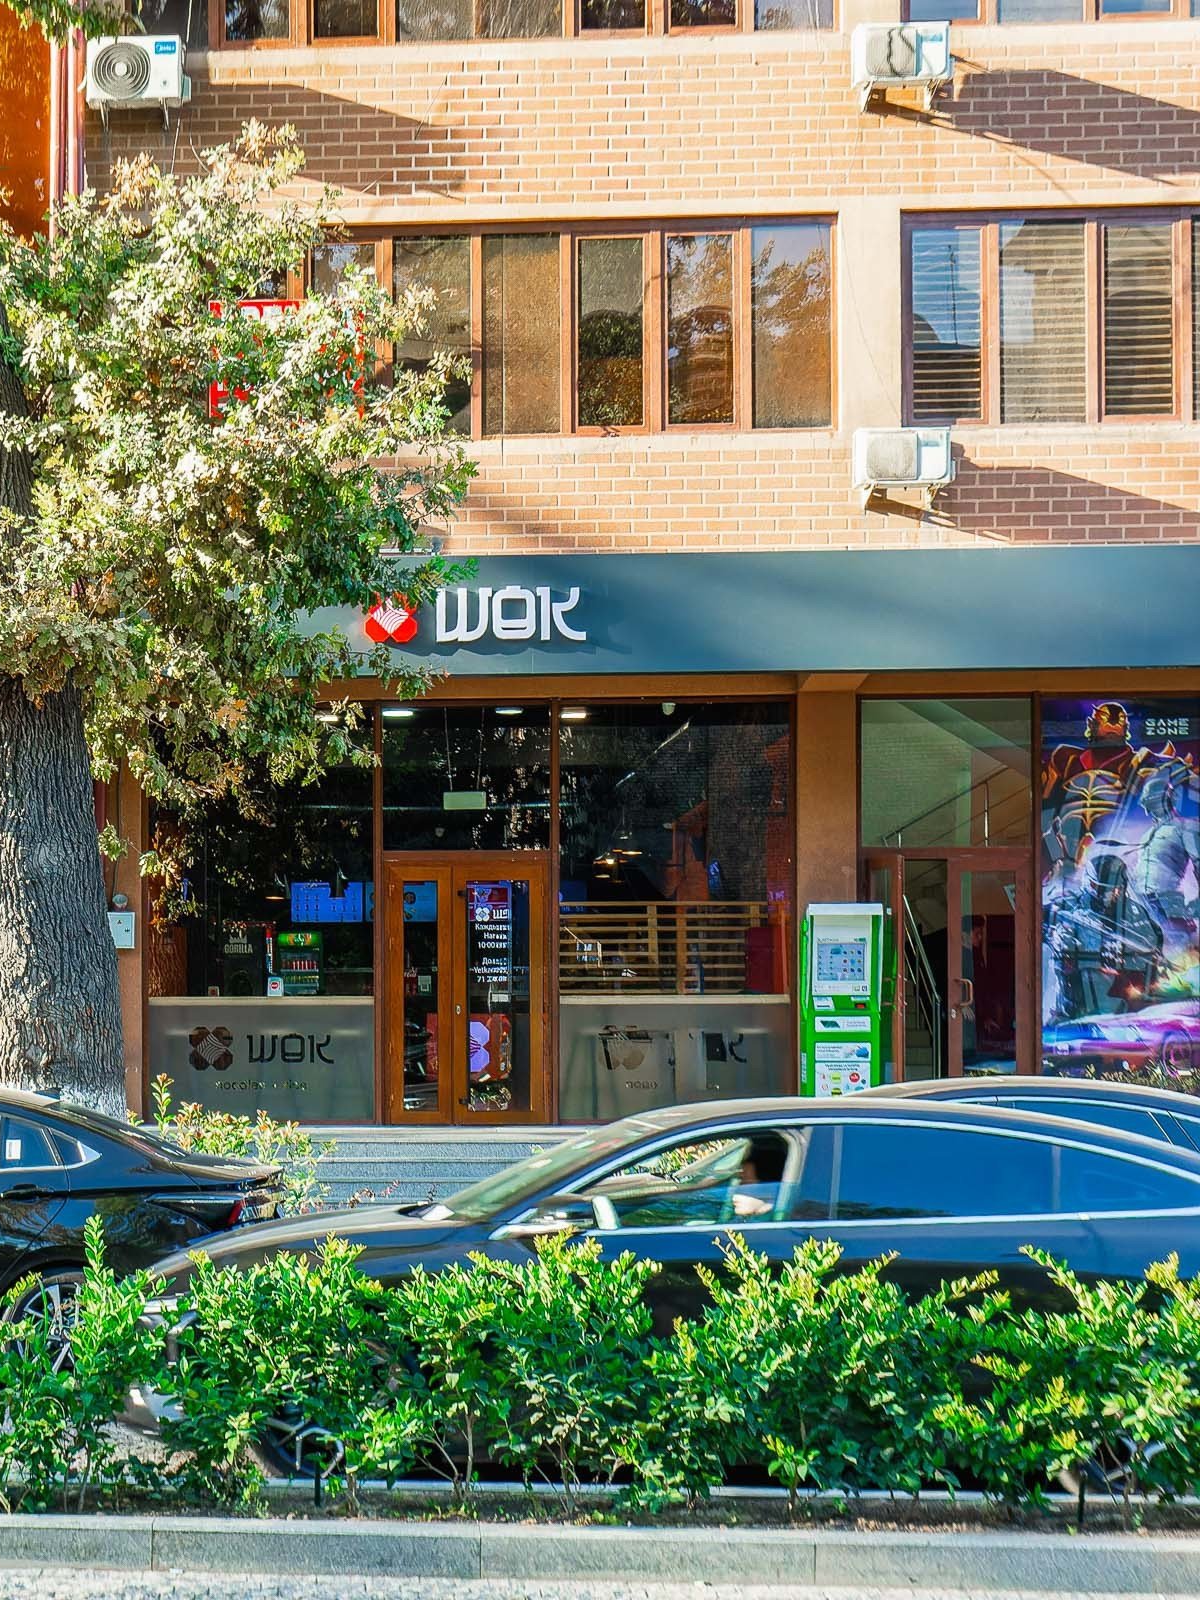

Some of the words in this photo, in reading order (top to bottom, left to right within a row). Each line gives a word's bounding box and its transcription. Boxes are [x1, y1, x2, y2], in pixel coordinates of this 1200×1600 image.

[436, 586, 586, 642] WOK
[1145, 718, 1189, 727] GAME
[1145, 727, 1189, 736] ZONE
[224, 943, 253, 954] GORILLA
[247, 1033, 334, 1064] WOK
